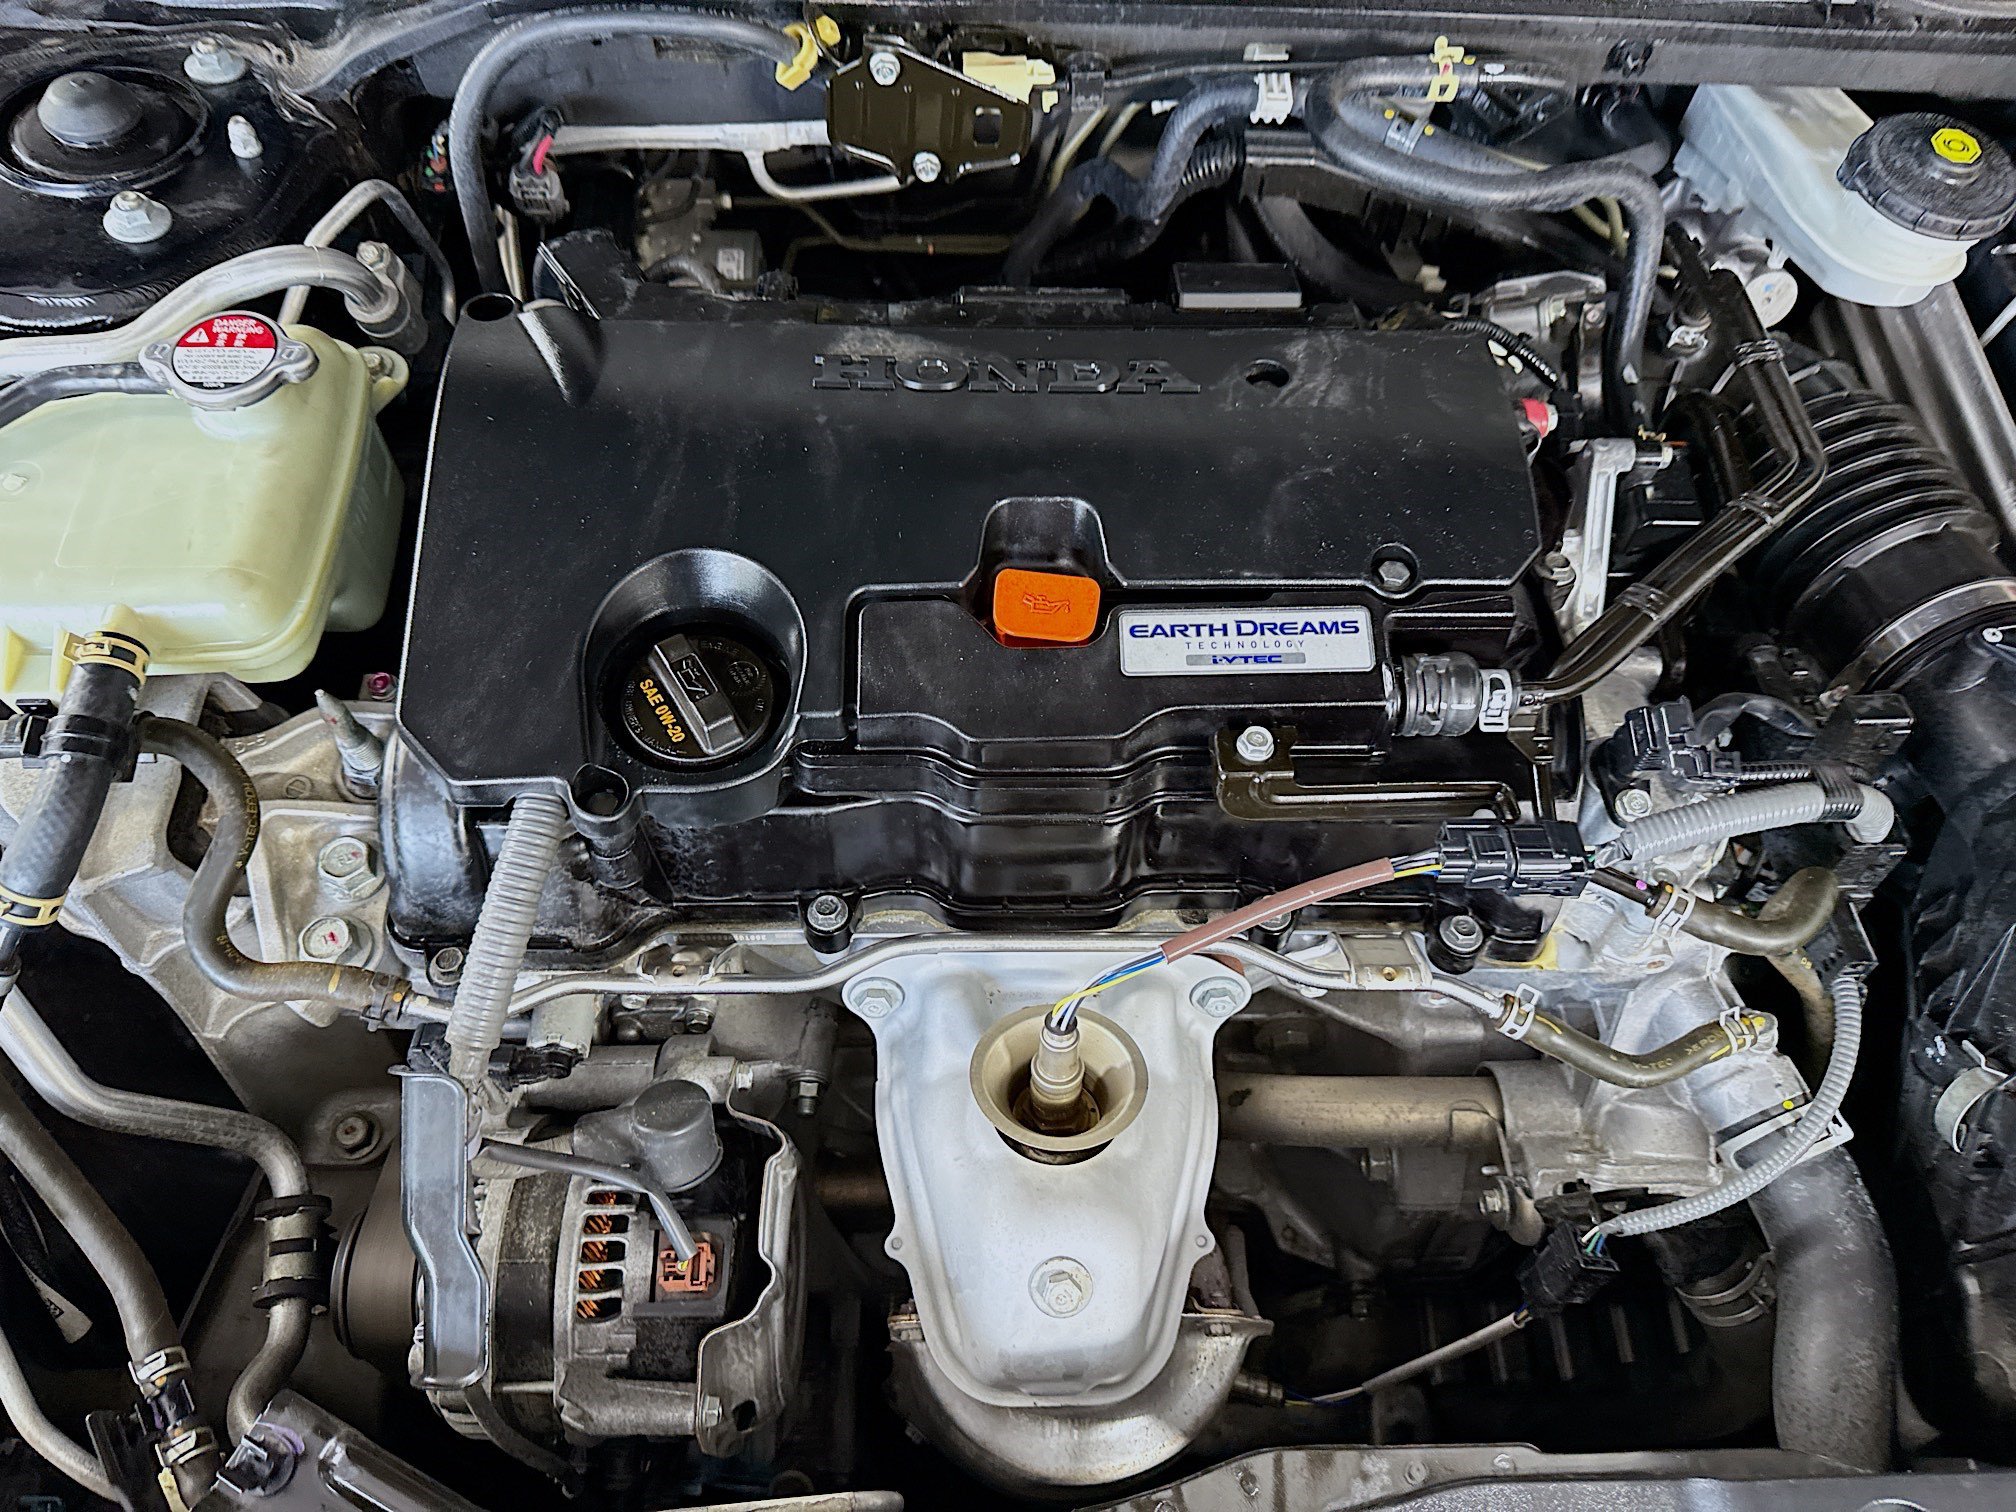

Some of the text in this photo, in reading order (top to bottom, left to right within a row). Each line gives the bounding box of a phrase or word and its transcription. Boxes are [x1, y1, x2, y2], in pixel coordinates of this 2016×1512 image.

[812, 354, 1200, 393] HONDA
[1129, 619, 1360, 638] EARTH DREAMS
[1185, 640, 1304, 650] TECHNOLOGY
[1212, 654, 1282, 664] i-VTEC
[640, 679, 685, 742] SAE 0W-20
